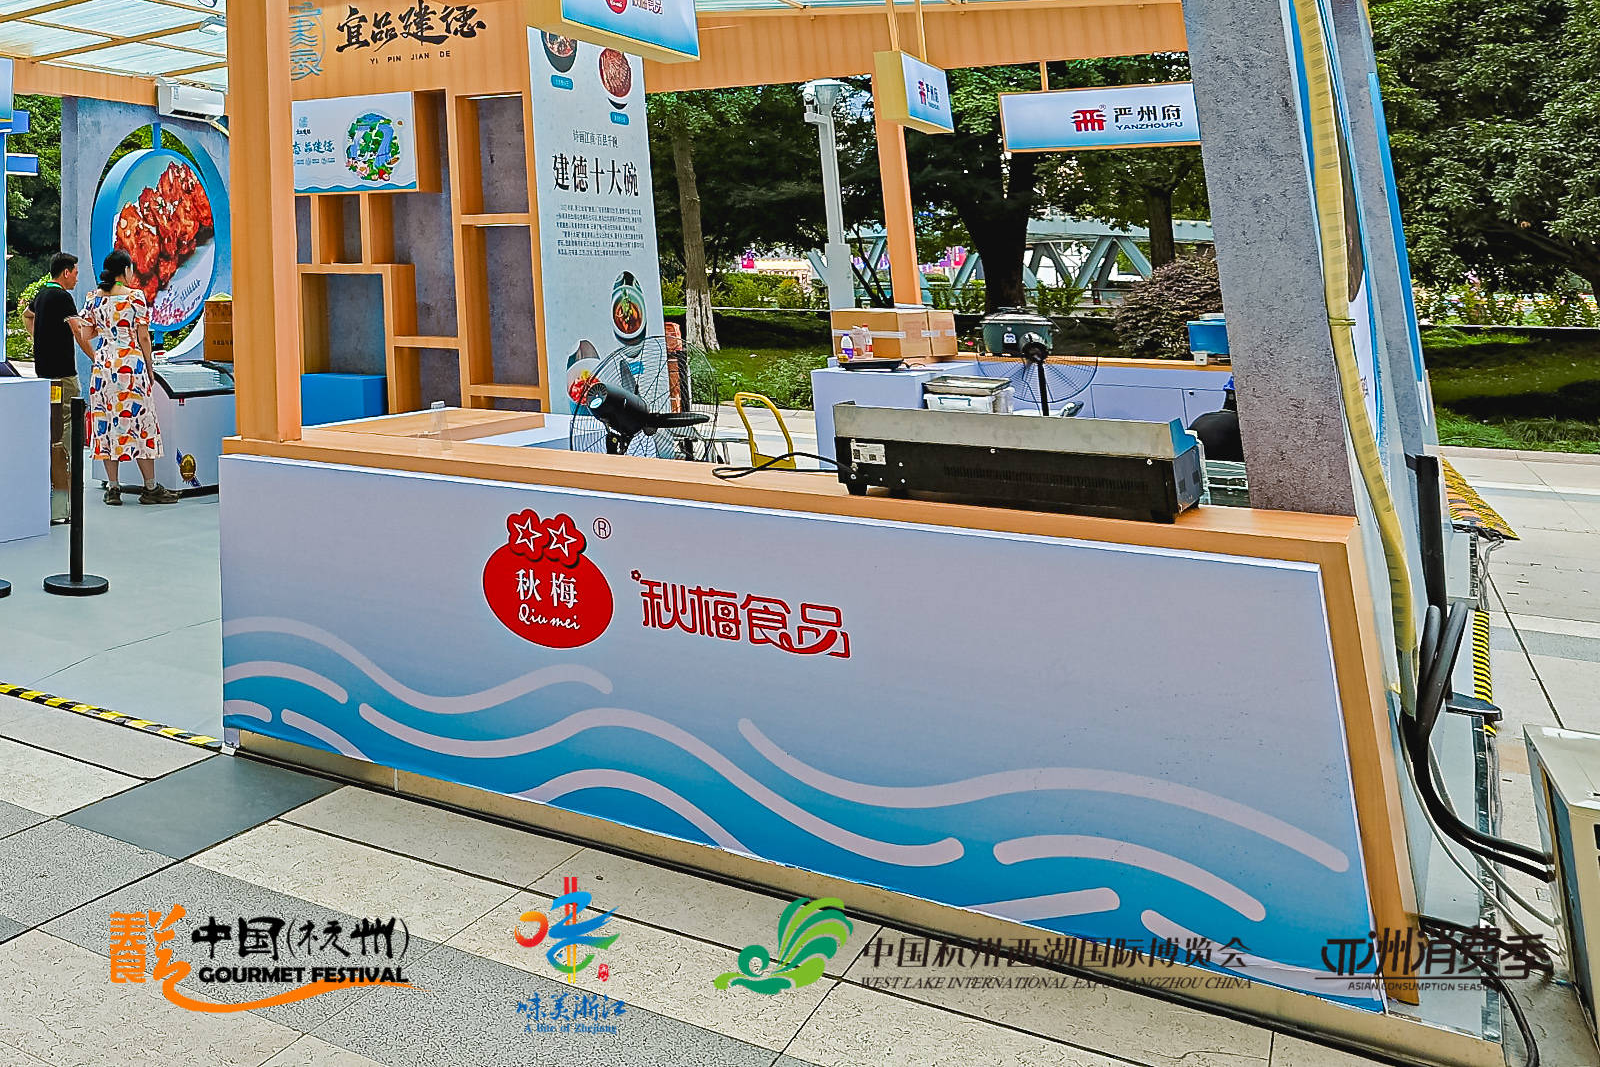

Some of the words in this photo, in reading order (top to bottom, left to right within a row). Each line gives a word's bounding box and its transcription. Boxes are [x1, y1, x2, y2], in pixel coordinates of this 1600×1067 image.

[370, 57, 379, 65] YI
[387, 55, 402, 63] PIN
[410, 52, 430, 61] JIAN
[439, 50, 451, 58] DE
[1113, 104, 1182, 123] 严州府
[1115, 120, 1184, 131] YANZHOUFU
[551, 152, 639, 197] 建德十大碗
[515, 568, 579, 608] 秋梅
[639, 578, 851, 659] 秋梅食品
